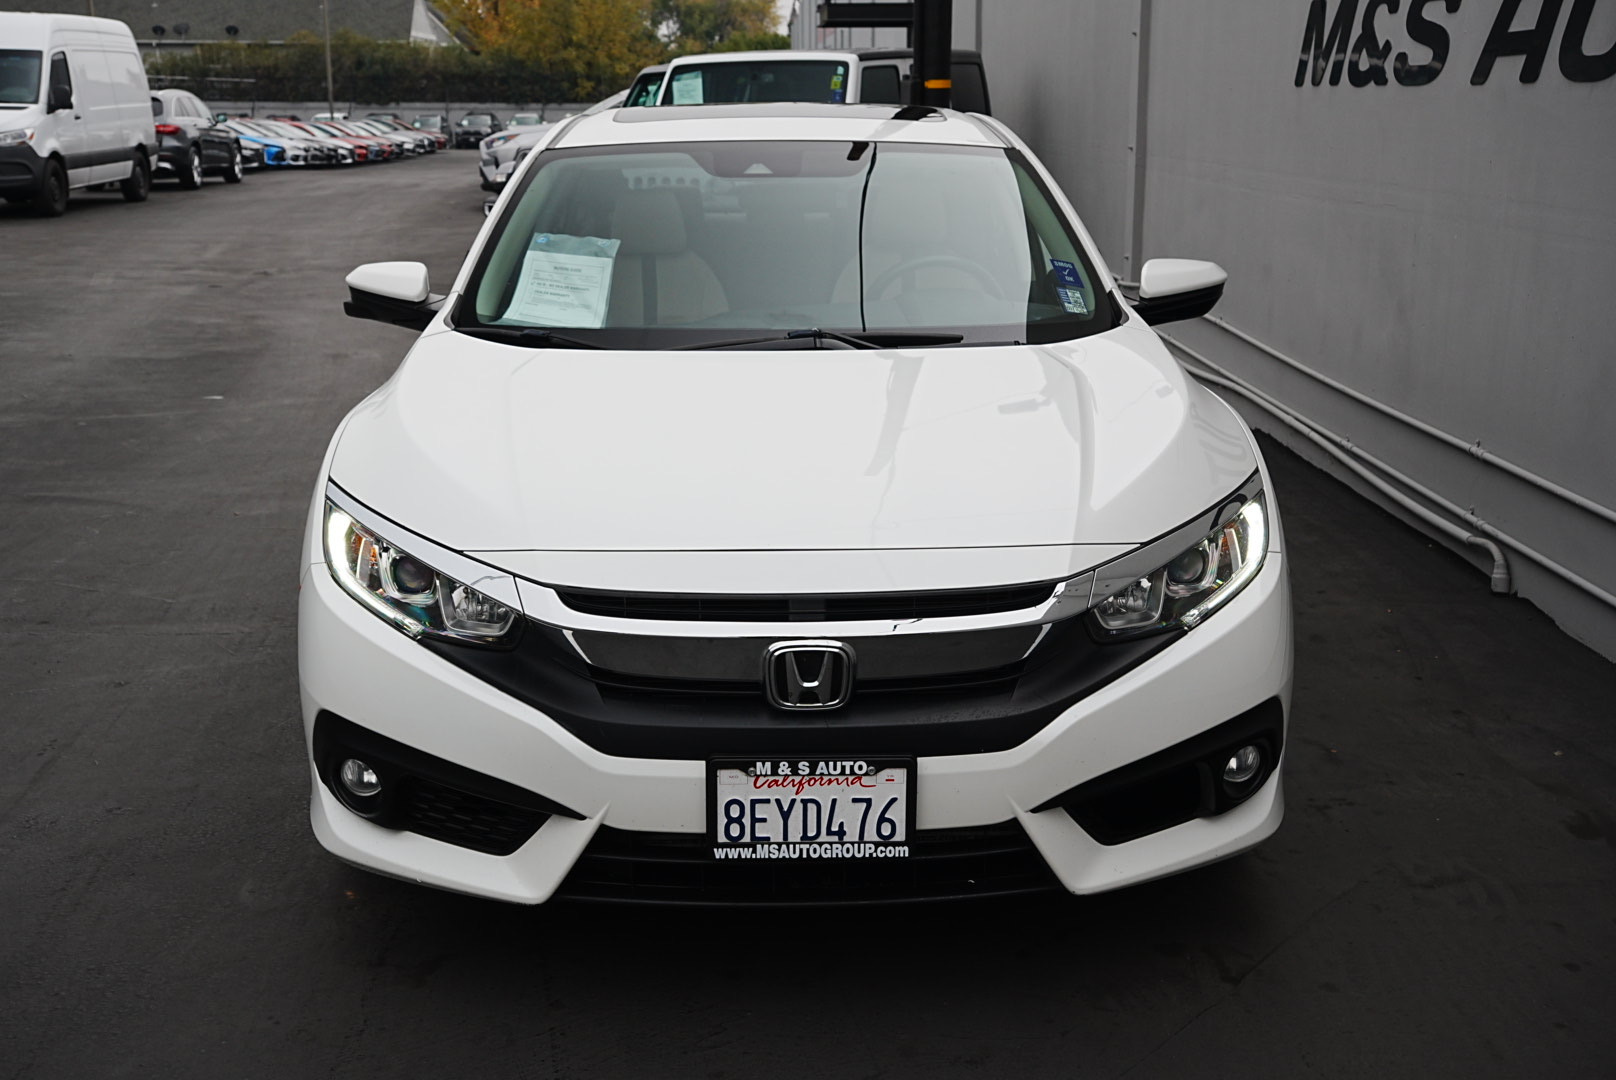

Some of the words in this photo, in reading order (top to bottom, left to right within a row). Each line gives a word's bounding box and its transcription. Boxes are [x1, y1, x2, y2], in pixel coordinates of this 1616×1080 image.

[1294, 0, 1462, 88] M&S
[756, 761, 771, 775] M
[777, 761, 792, 775] &
[798, 761, 811, 775] S
[816, 760, 868, 775] AUTO
[753, 775, 876, 796] California
[723, 797, 899, 842] 8EYD476
[713, 843, 909, 859] www.MSAUTOGROUP.com
